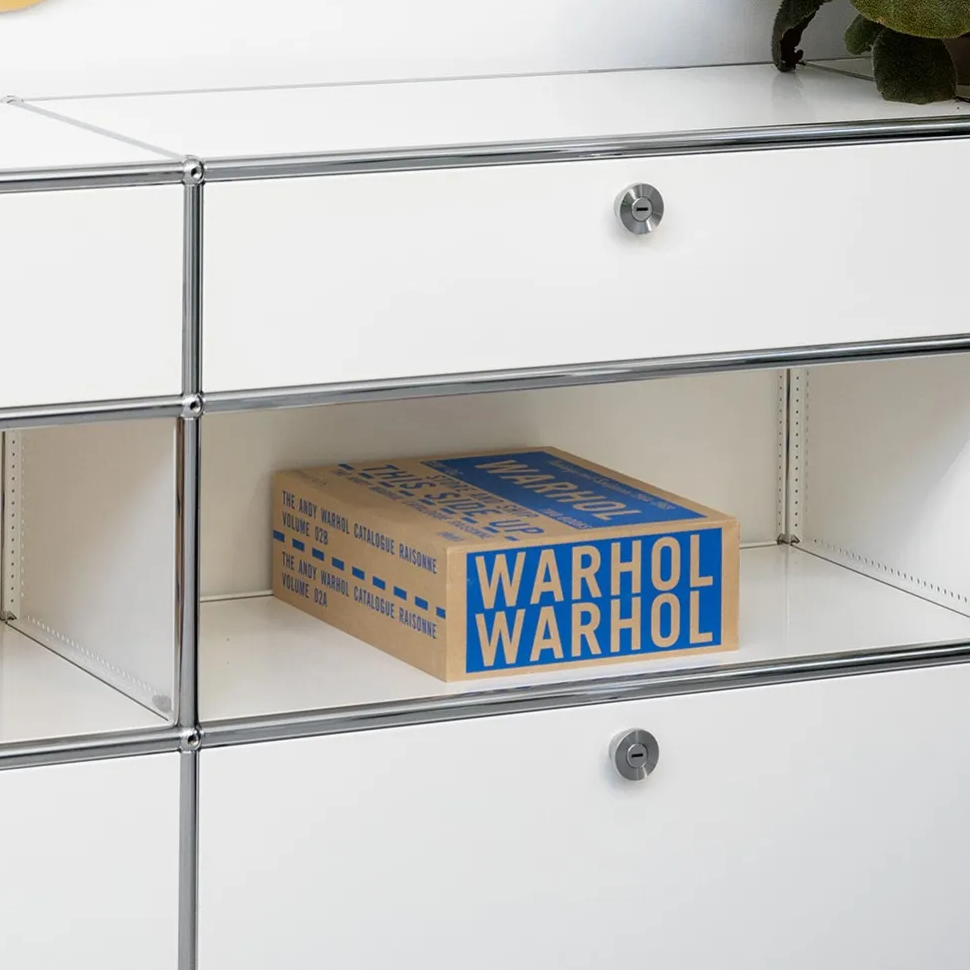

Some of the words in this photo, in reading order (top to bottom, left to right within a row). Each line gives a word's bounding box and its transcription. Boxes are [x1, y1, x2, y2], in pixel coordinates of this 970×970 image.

[364, 464, 436, 490] THIS
[419, 492, 507, 517] SIDE
[492, 519, 545, 534] UP
[475, 459, 642, 520] WARHOL
[282, 511, 310, 537] VOLUME
[314, 526, 329, 545] 02B
[282, 490, 295, 510] THE
[299, 499, 317, 519] ANDY
[321, 508, 350, 534] WARHOL
[354, 523, 395, 555] CATALOGUE
[399, 543, 437, 574] RAISONNE
[282, 572, 310, 599] VOLUME
[313, 588, 328, 608] 02A
[282, 551, 295, 571] THE
[298, 560, 317, 580] ANDY
[321, 570, 350, 598] WARHOL
[353, 586, 395, 619] CATALOGUE
[399, 606, 437, 639] RAISONNE
[475, 534, 714, 609] WARHOL
[475, 590, 714, 666] WARHOL
